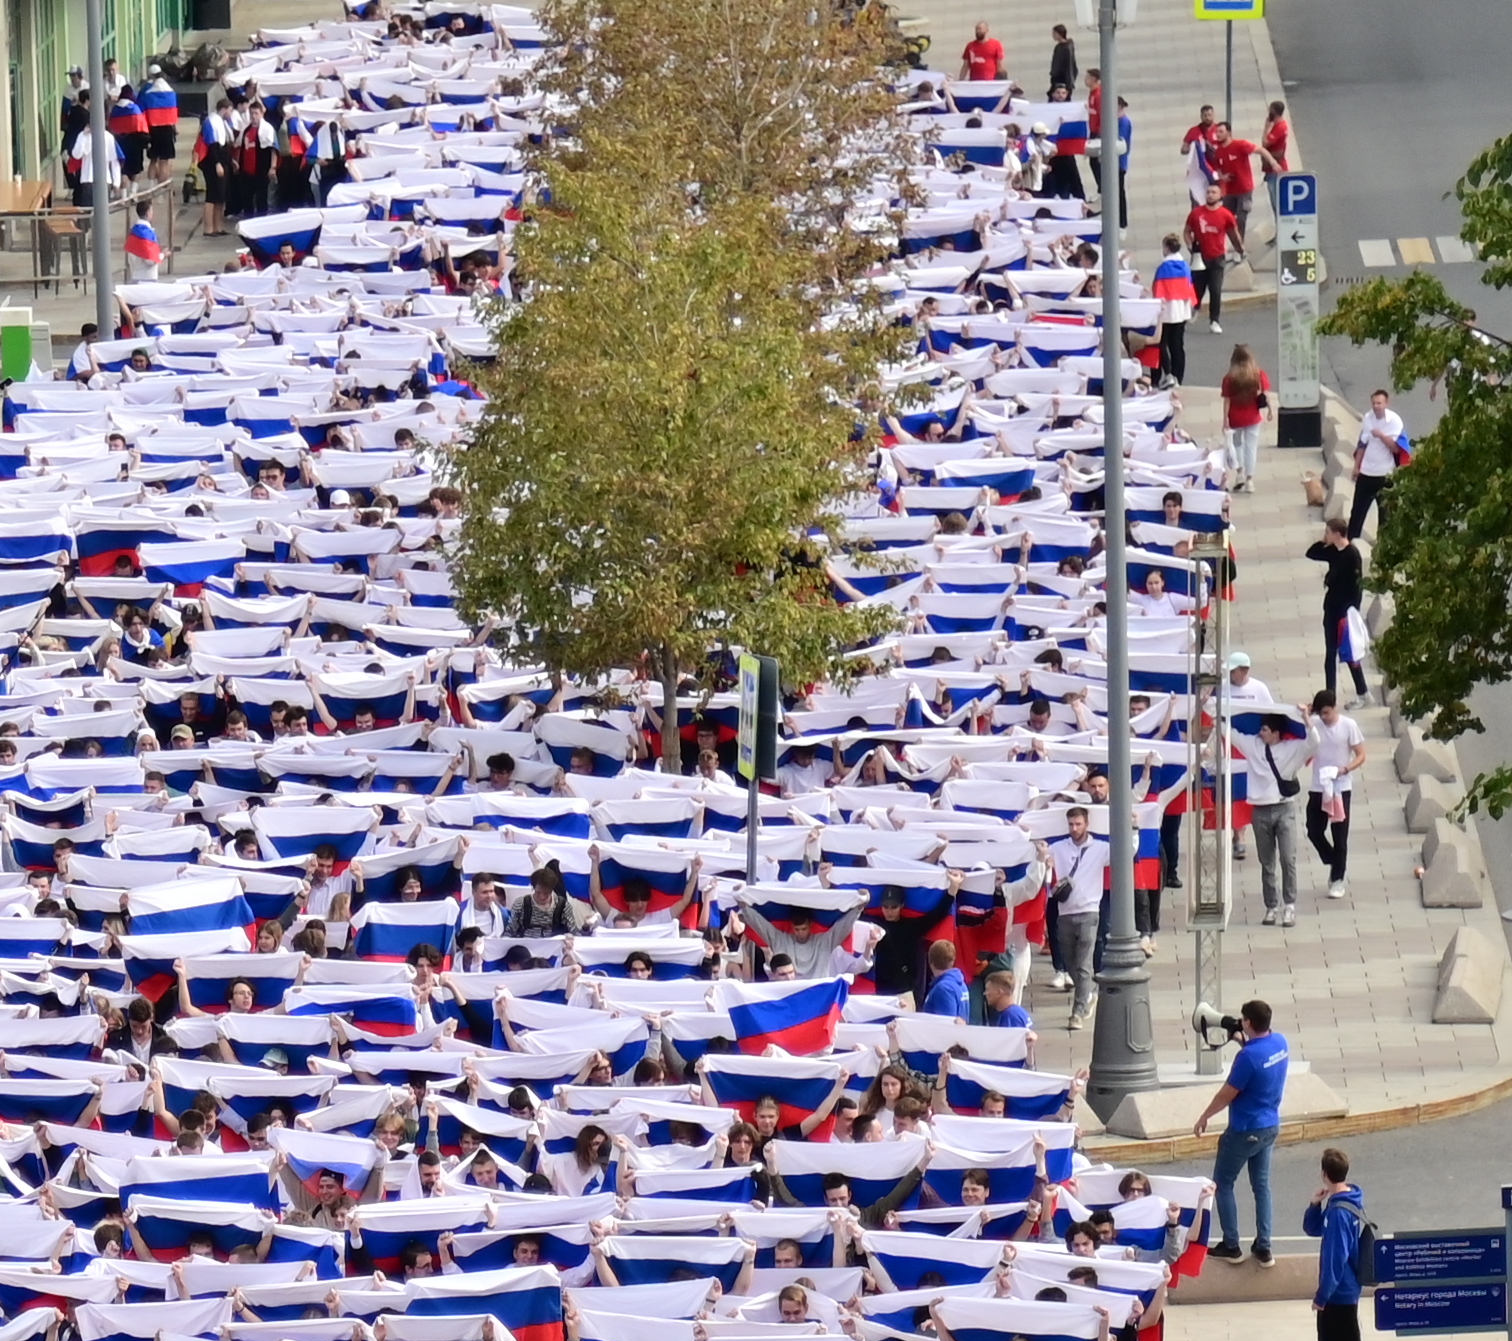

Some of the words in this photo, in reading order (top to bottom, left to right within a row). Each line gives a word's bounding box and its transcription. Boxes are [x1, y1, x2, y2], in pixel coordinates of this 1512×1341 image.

[1287, 180, 1310, 212] P
[1297, 251, 1316, 265] 23
[1306, 268, 1316, 281] 5
